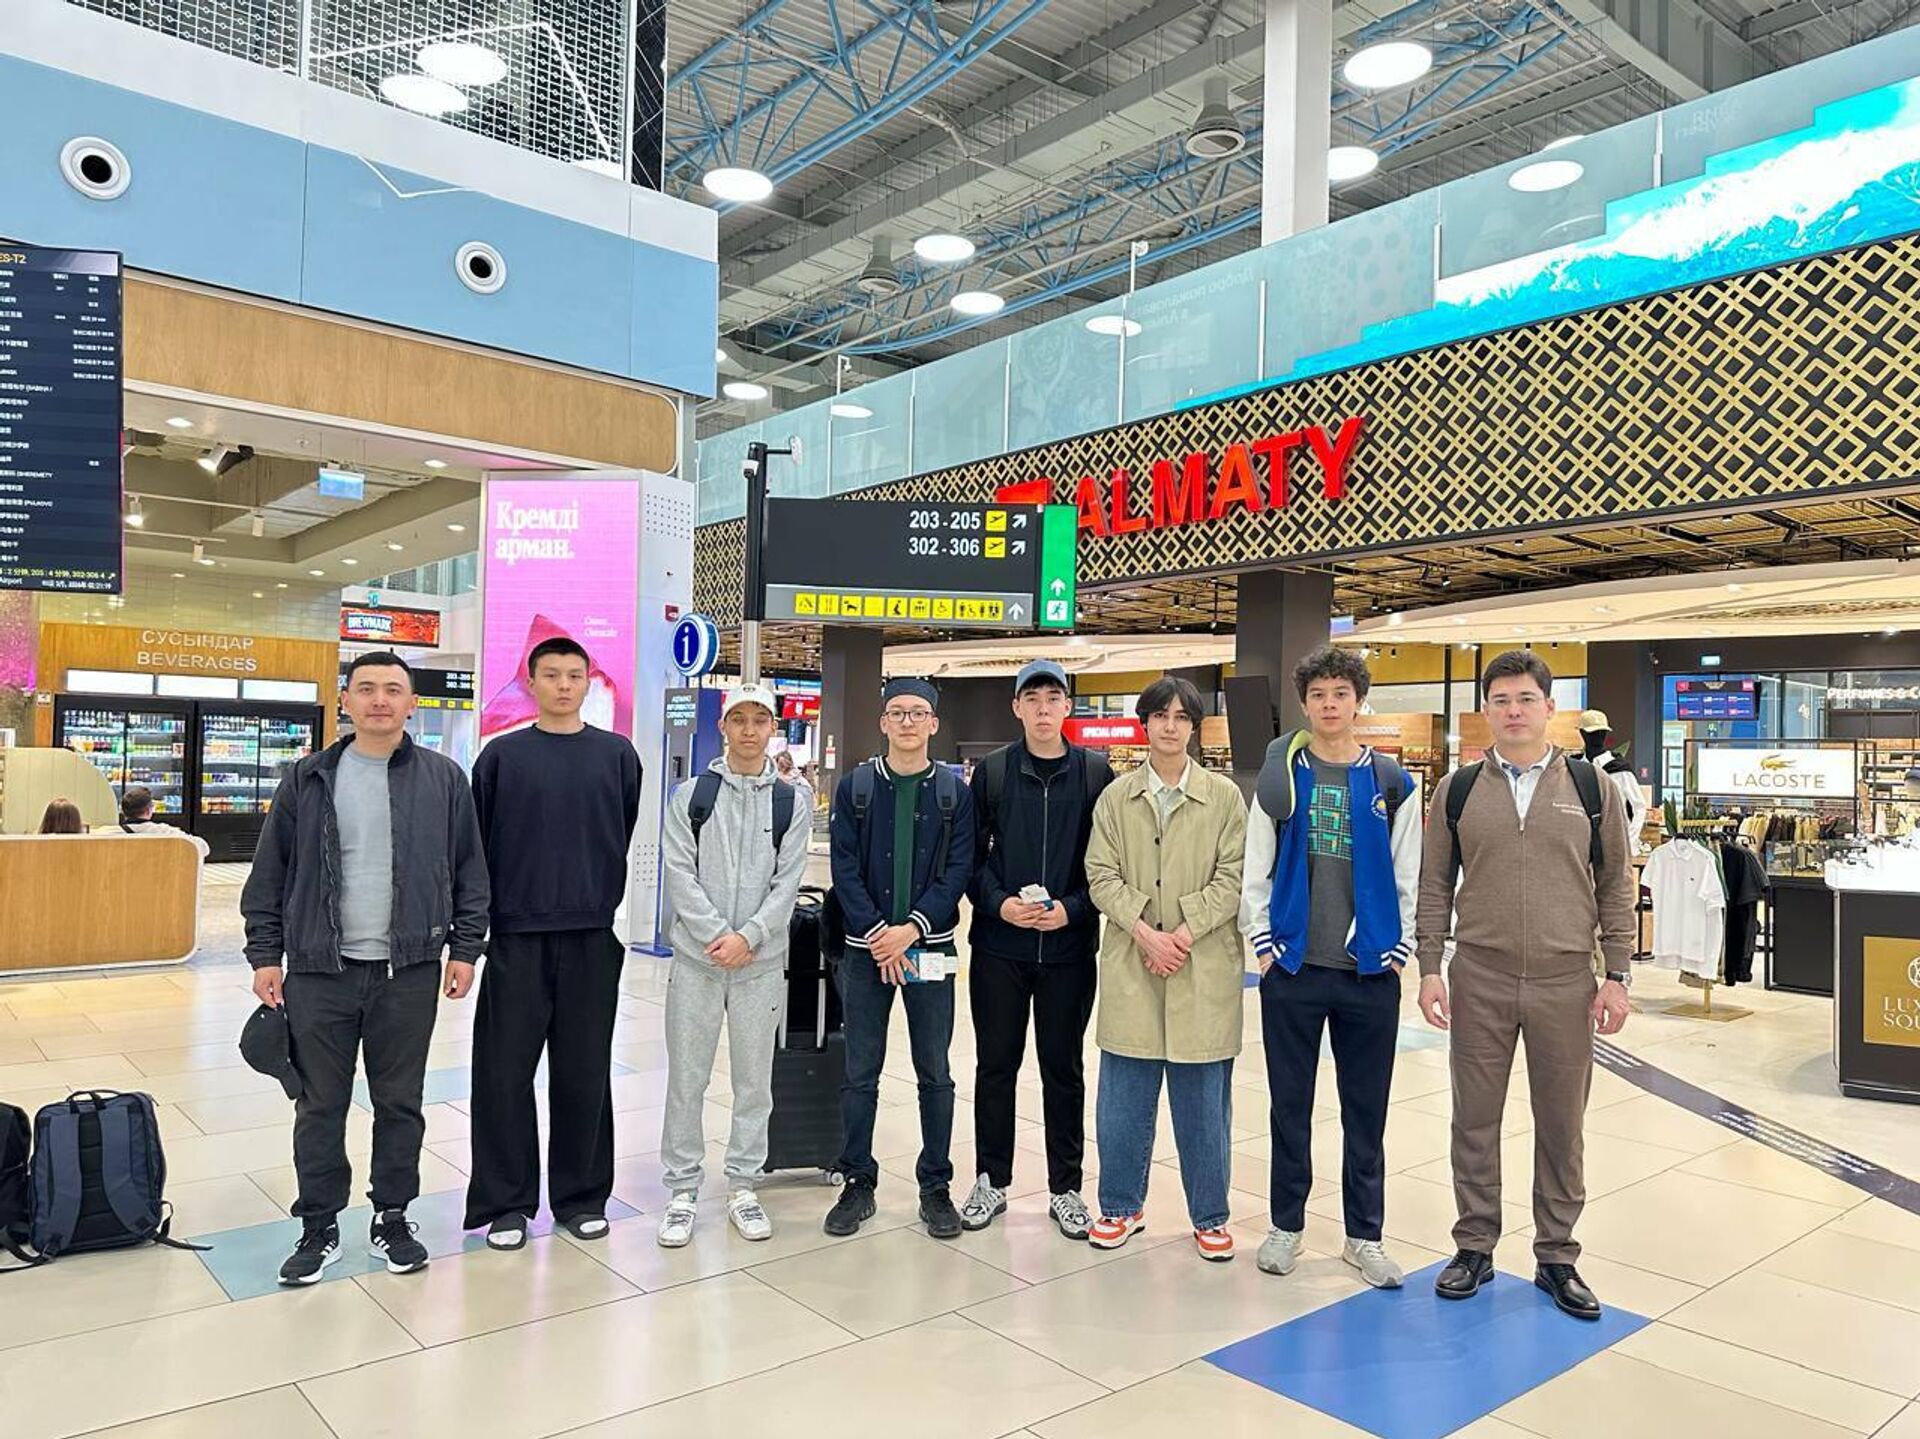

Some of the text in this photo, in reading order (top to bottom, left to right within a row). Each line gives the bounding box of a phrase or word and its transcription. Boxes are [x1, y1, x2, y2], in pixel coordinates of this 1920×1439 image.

[1076, 416, 1364, 537] ALMATY
[495, 500, 579, 536] Кремді
[910, 510, 939, 529] 203
[950, 511, 980, 529] 205
[495, 538, 576, 566] арман.
[909, 537, 939, 555] 302
[950, 538, 980, 556] 306
[142, 630, 254, 651] СУСЫНДАР
[137, 651, 257, 671] BEVERAGES
[1827, 687, 1895, 700] PERFUMES
[1733, 773, 1826, 789] LACOSTE
